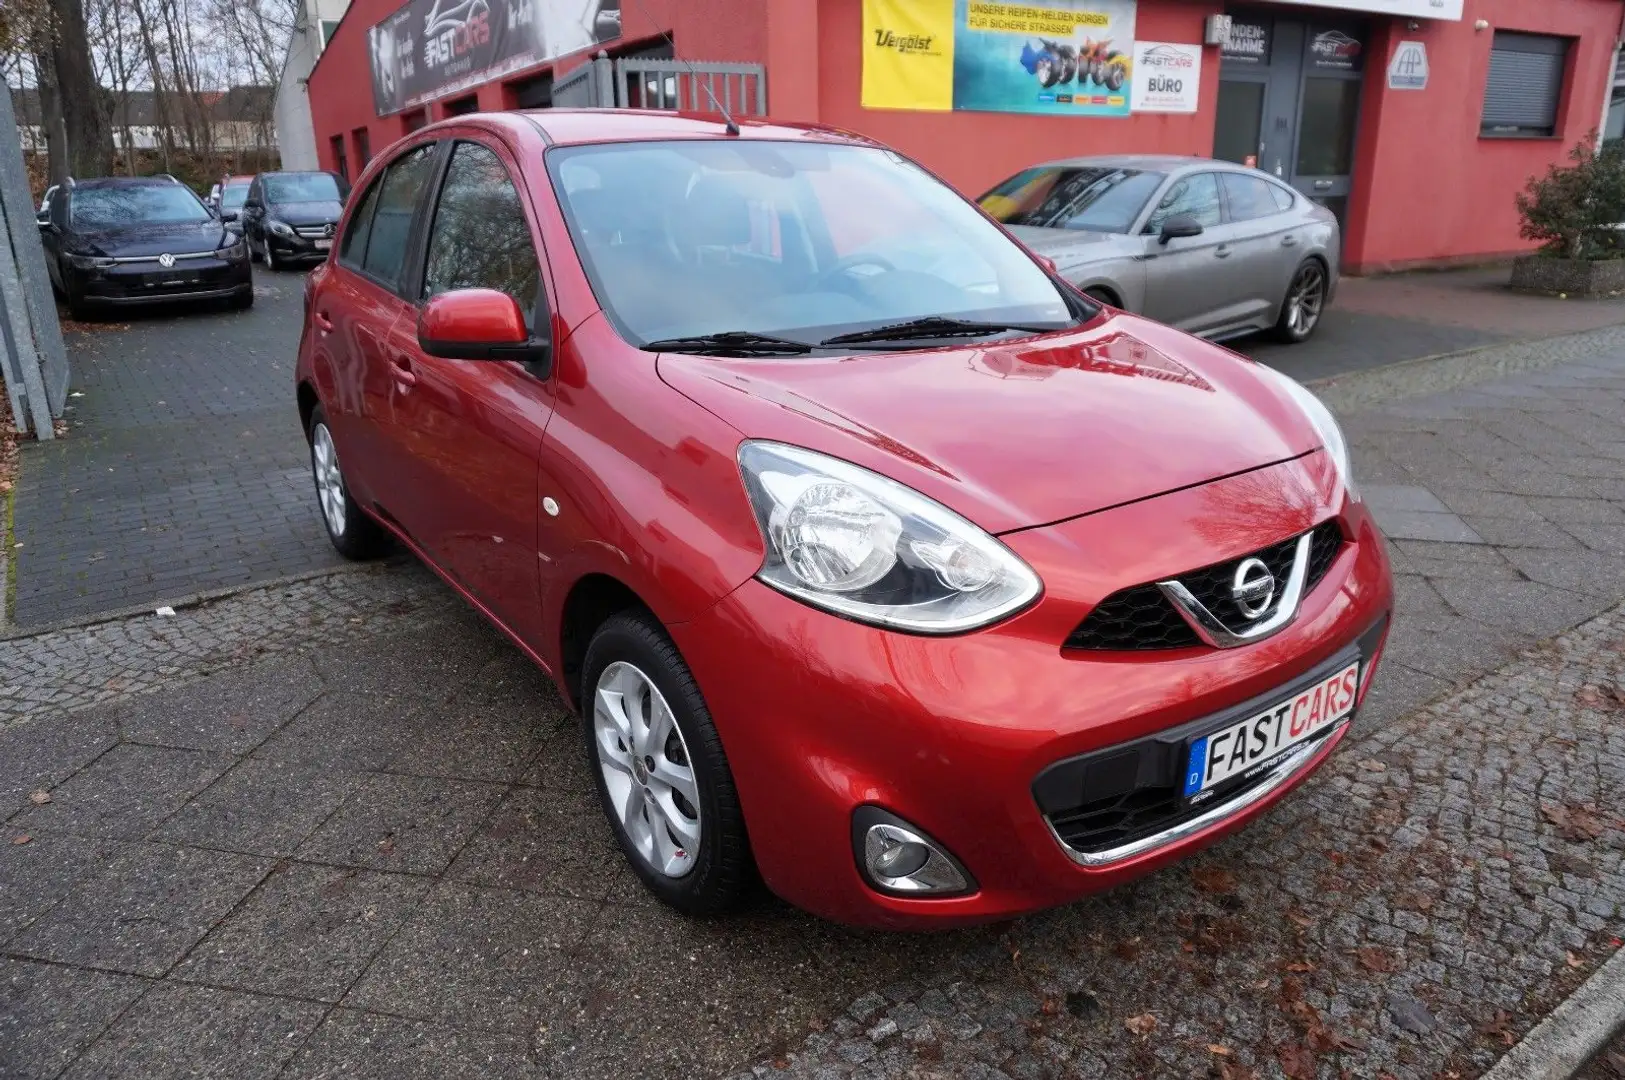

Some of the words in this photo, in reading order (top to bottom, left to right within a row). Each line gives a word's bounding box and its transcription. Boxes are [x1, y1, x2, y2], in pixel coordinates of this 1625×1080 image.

[970, 4, 1005, 16] UNSERE
[1007, 6, 1074, 21] REIFEN-HELDEN
[1076, 12, 1109, 25] SORGEN
[989, 19, 1027, 31] SICHERE
[1029, 21, 1073, 34] STRASSEN
[424, 11, 490, 69] FASTCARS
[1140, 56, 1193, 68] FASTCARS
[1148, 74, 1183, 93] BÜRO
[1206, 667, 1357, 782] FASTCARS
[1189, 771, 1199, 786] D
